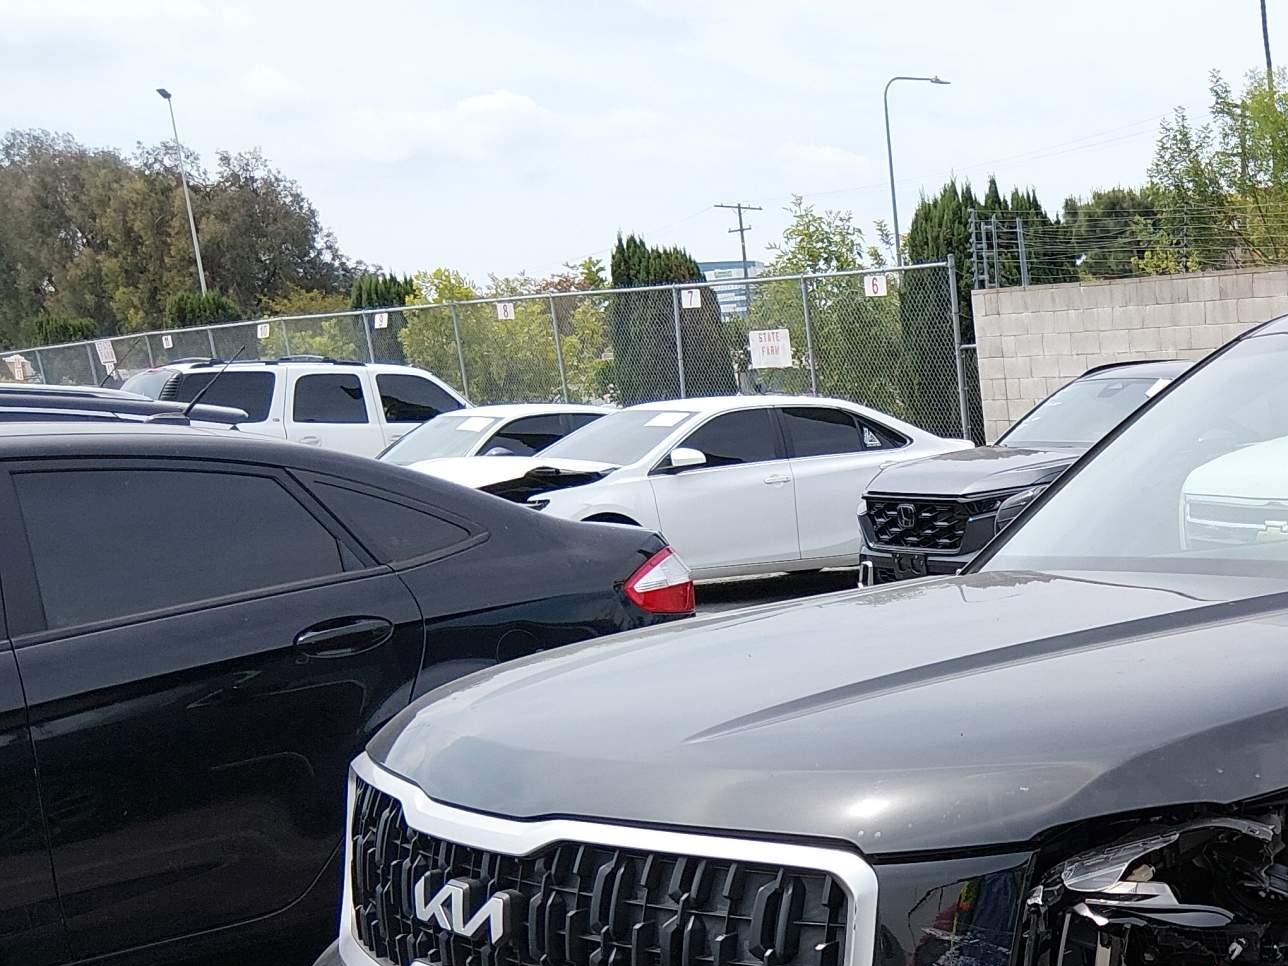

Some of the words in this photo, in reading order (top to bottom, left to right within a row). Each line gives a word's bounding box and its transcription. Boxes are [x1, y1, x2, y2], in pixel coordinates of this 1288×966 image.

[871, 276, 879, 295] 6
[687, 290, 694, 307] 7
[502, 304, 509, 318] 8
[758, 331, 781, 343] STATE
[761, 345, 780, 356] FARM
